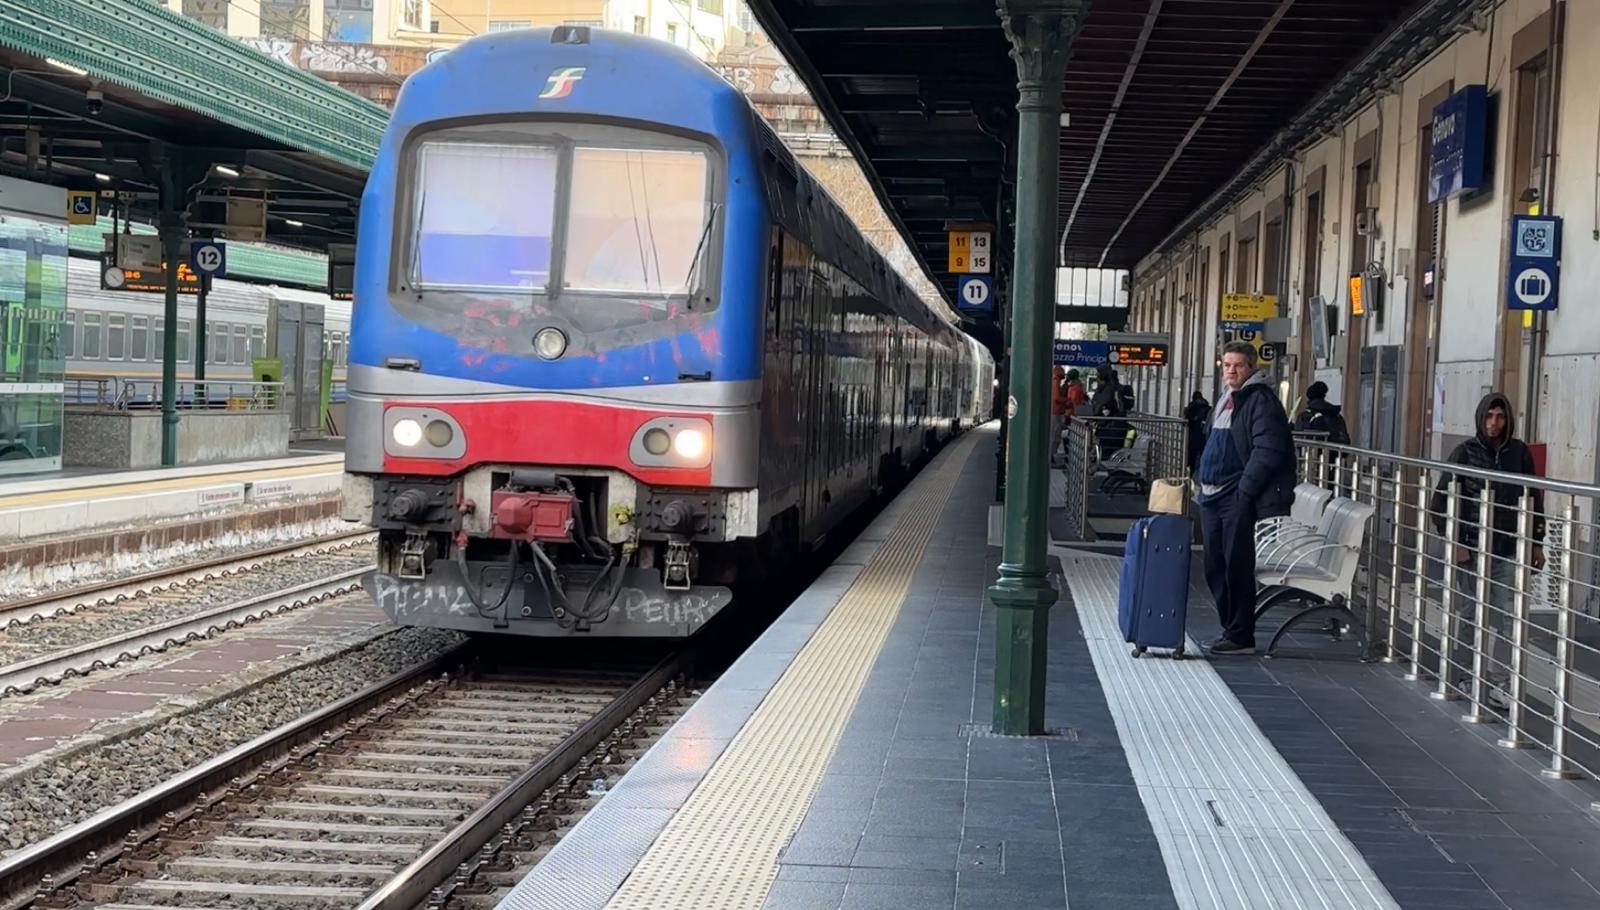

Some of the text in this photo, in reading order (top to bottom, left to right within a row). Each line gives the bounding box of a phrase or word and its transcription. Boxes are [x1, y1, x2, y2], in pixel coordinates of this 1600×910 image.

[956, 237, 986, 247] 11 13
[200, 251, 218, 265] 12
[956, 257, 986, 267] 9 15
[969, 285, 982, 299] 11
